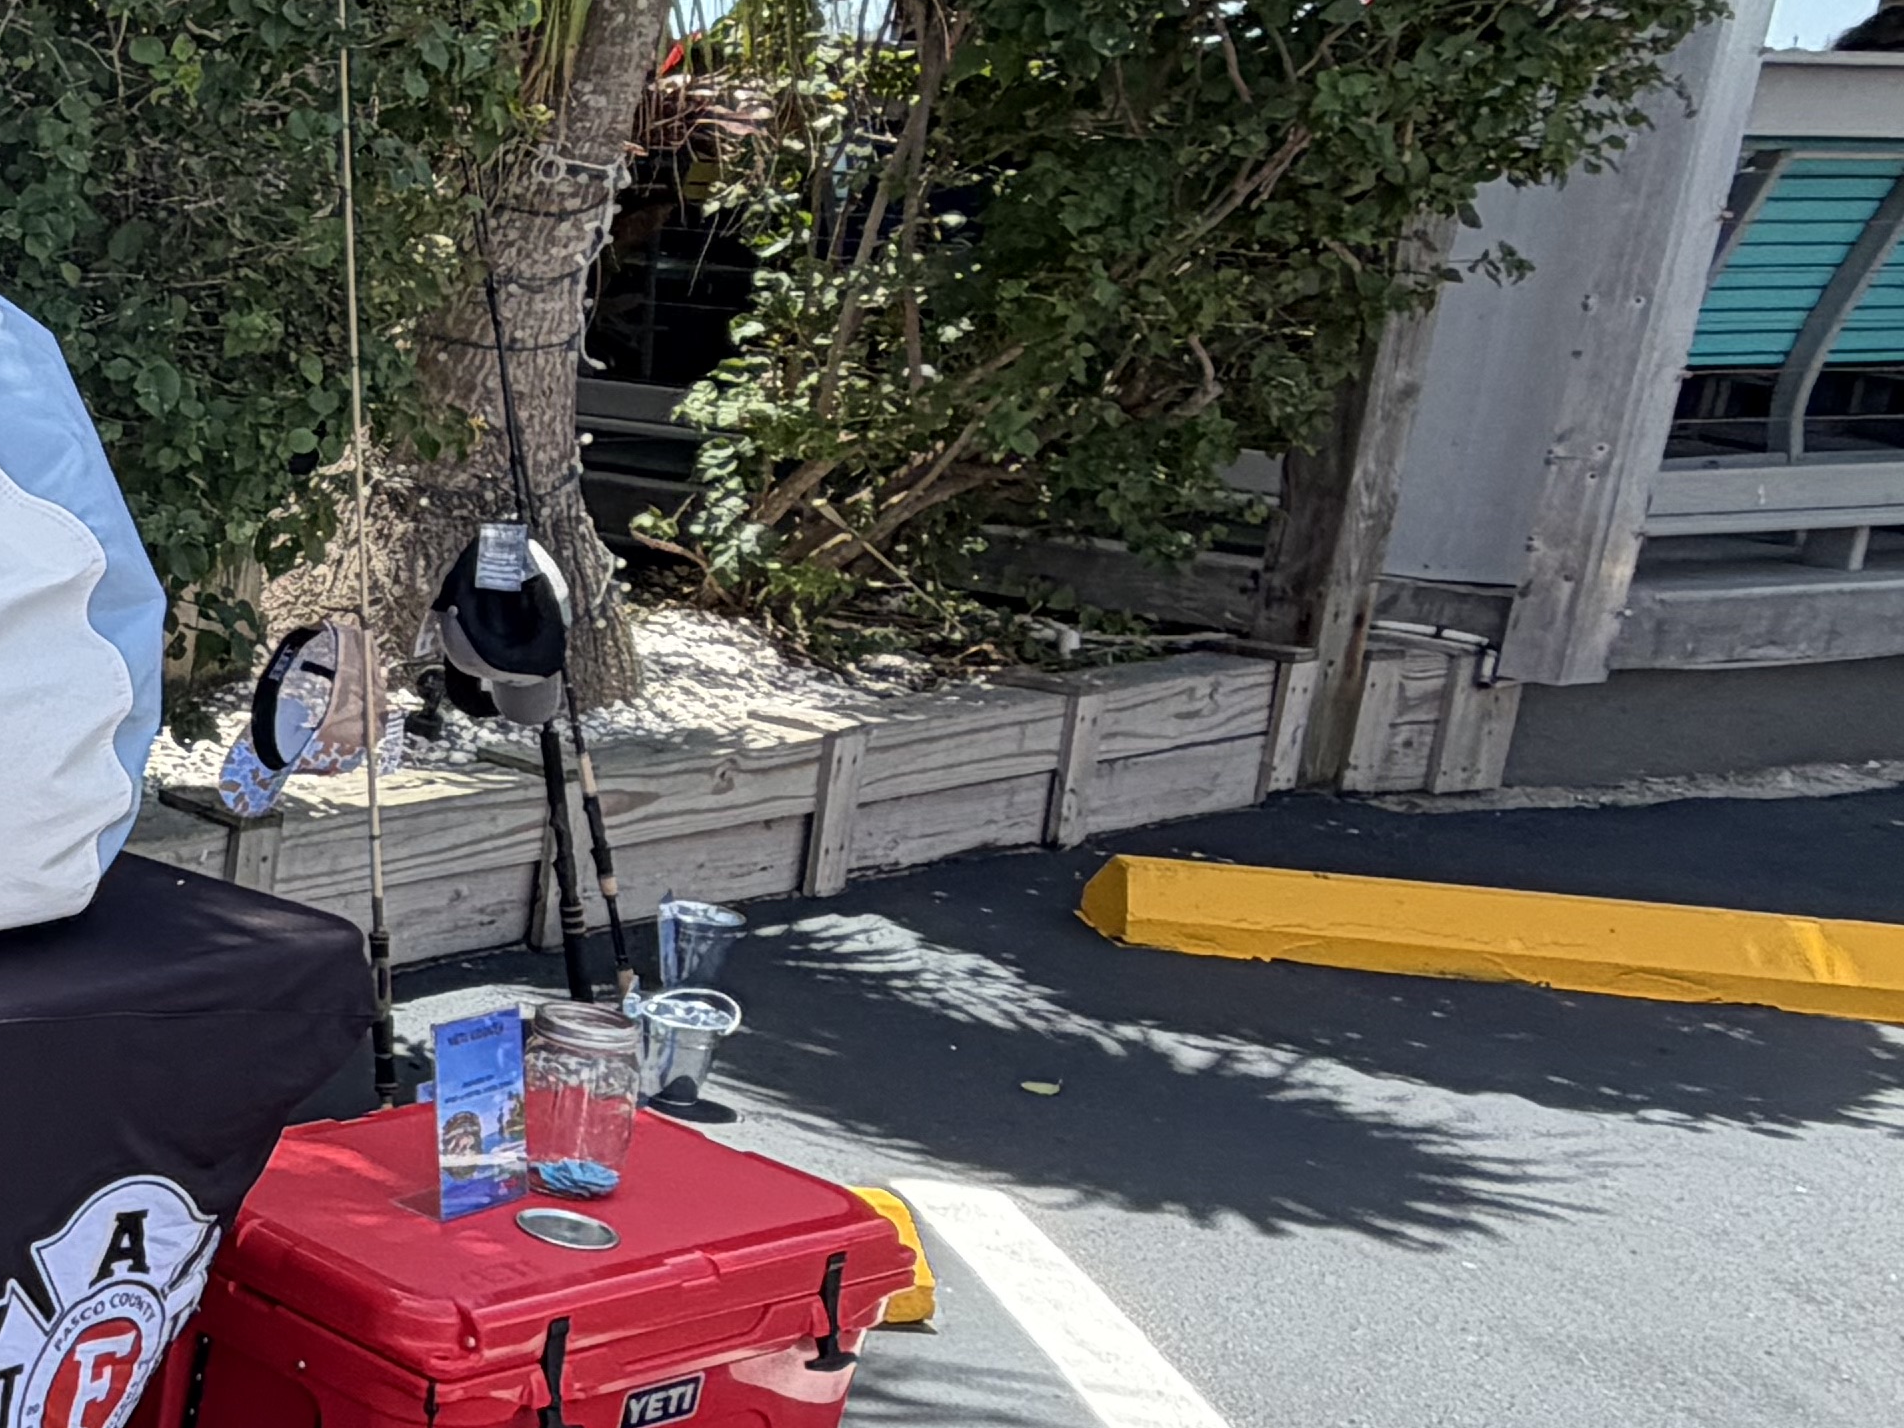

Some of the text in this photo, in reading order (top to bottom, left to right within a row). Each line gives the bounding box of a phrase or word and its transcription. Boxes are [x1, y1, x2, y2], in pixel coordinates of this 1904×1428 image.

[88, 1209, 151, 1289] A
[52, 1291, 156, 1353] PASCO COUNTY
[628, 1382, 697, 1425] YETI
